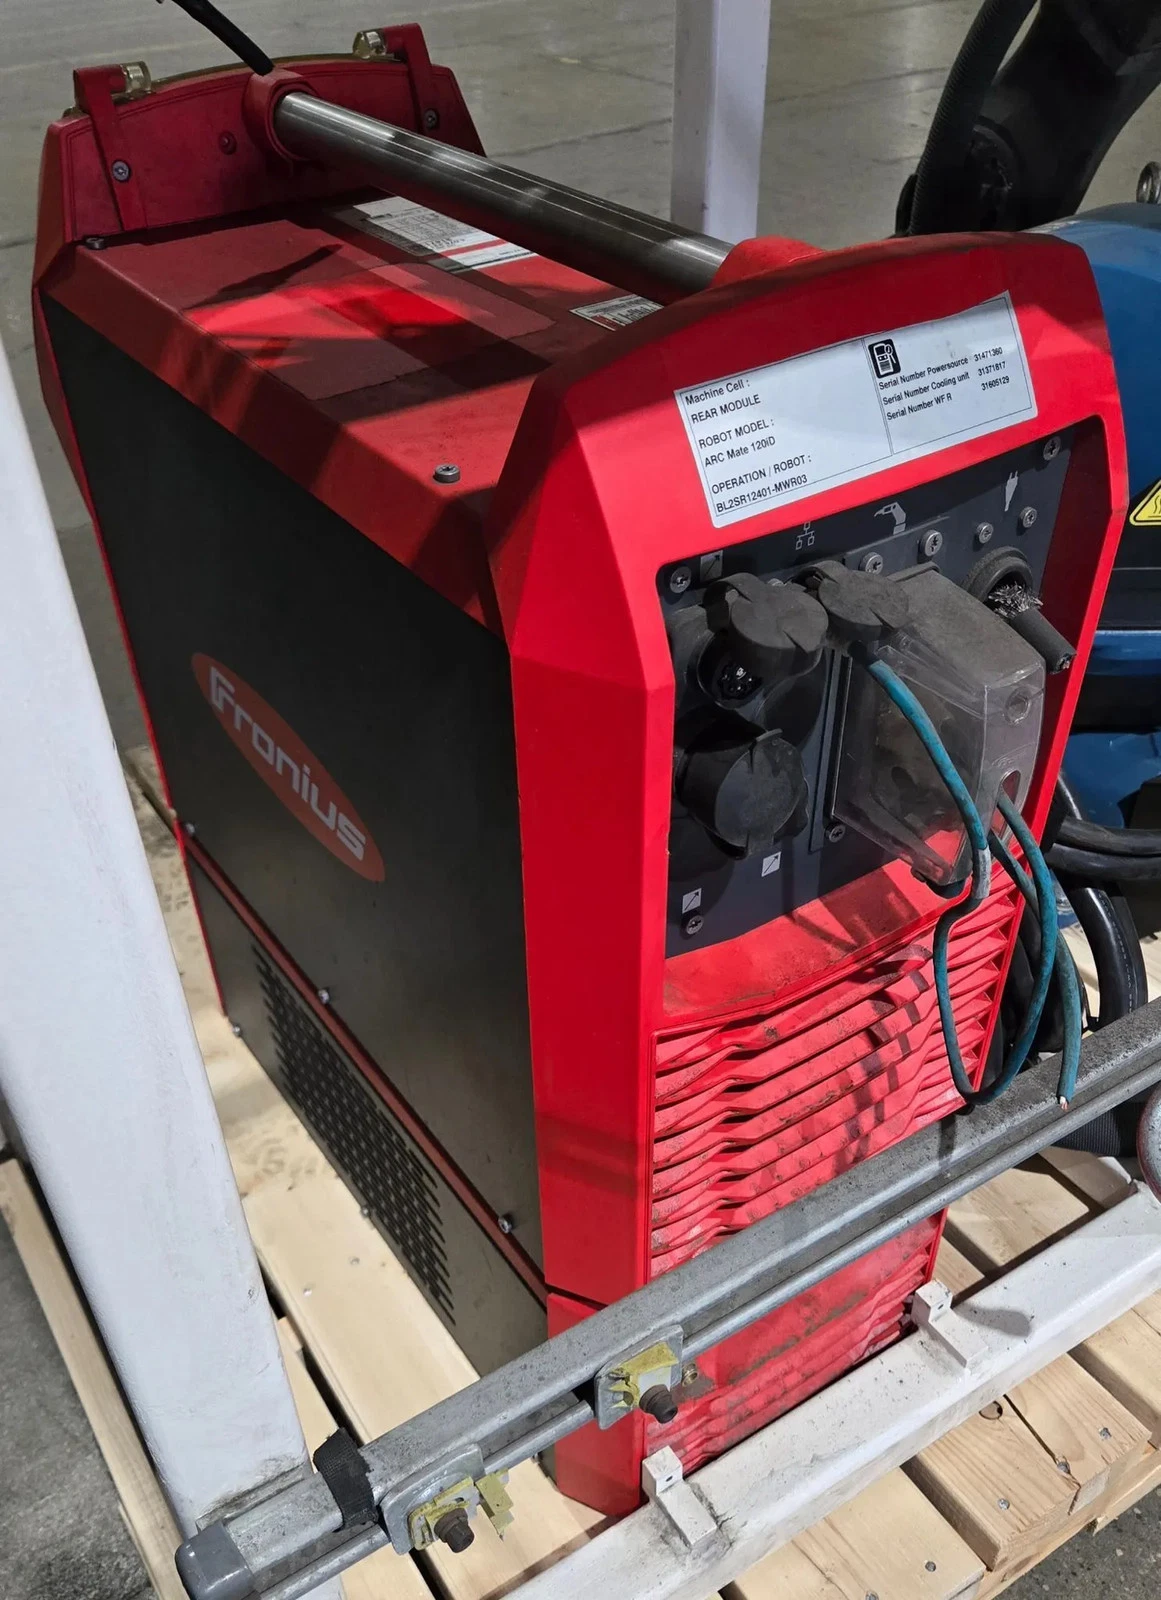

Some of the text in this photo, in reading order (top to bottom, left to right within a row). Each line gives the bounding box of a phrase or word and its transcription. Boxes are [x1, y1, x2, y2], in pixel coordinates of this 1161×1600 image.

[879, 347, 1003, 390] Serial Number Powersource 31471360
[685, 388, 724, 405] Machine
[726, 380, 744, 393] Cell
[883, 394, 903, 405] Serial
[905, 385, 930, 397] Number
[931, 377, 957, 390] Cooling
[957, 372, 969, 382] unit
[691, 394, 761, 424] REAR MODULE
[887, 410, 906, 420] Serial
[908, 399, 933, 414] Number
[934, 396, 945, 405] WF
[947, 393, 952, 402] R
[699, 430, 732, 449] ROBOT
[735, 419, 769, 437] MODEL
[704, 436, 776, 467] ARC Mate 120iD
[712, 468, 766, 494] OPERATION
[774, 455, 805, 473] ROBOT
[716, 474, 808, 512] BL2SR12401-MWR03
[209, 666, 366, 861] Fronius
